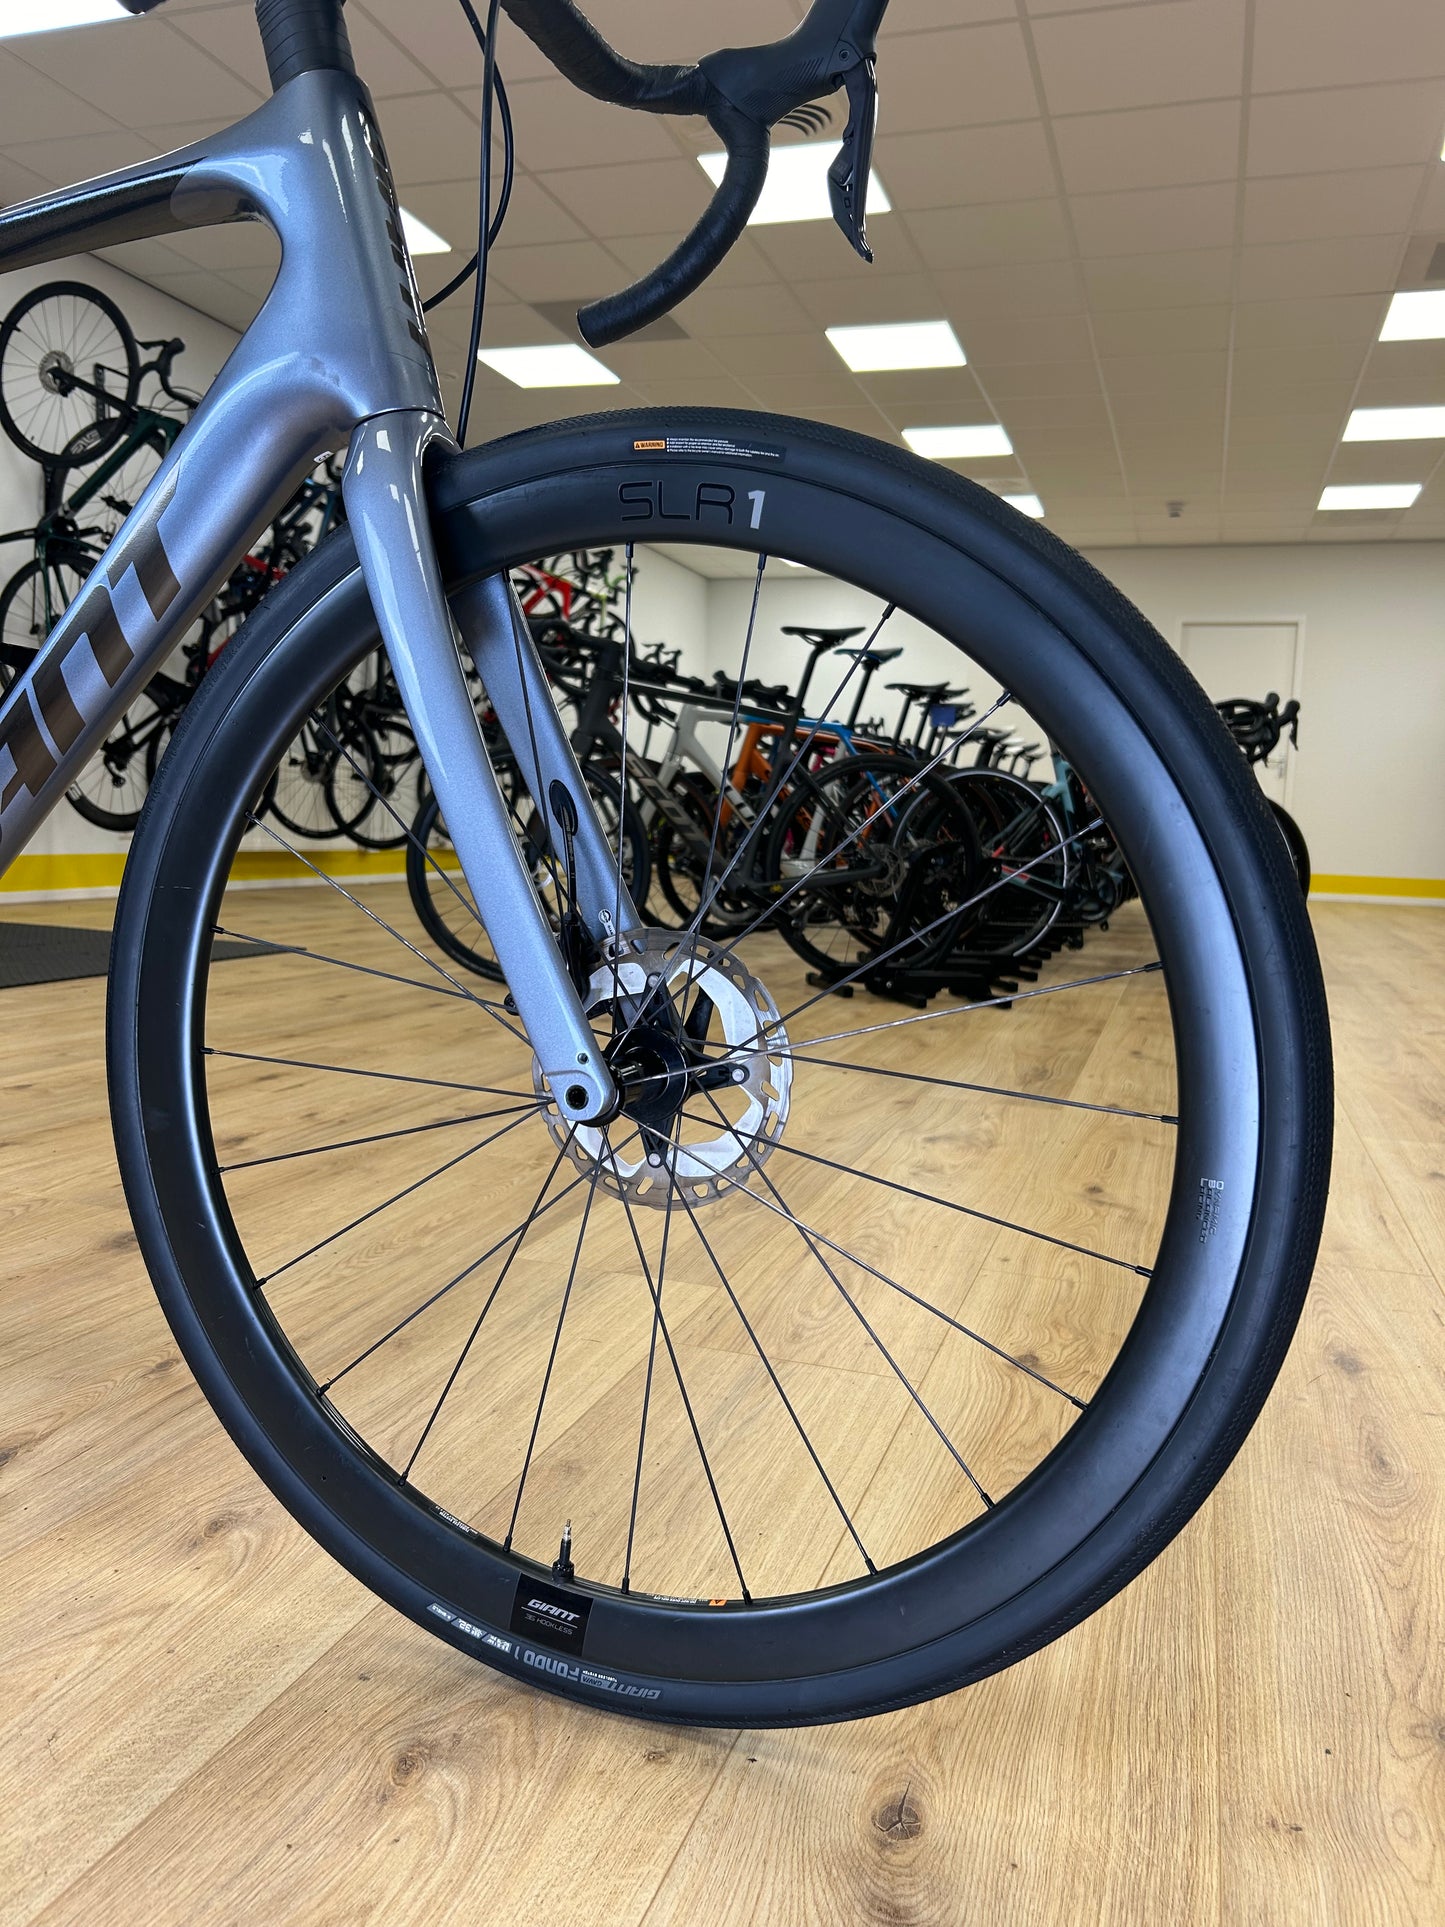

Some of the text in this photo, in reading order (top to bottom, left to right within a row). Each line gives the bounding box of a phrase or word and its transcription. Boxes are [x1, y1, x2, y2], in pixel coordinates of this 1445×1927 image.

[641, 441, 664, 449] WARNING
[618, 480, 766, 530] SLR 1
[527, 1598, 581, 1622] GIANT
[537, 1618, 573, 1635] HOOKLESS
[523, 1649, 580, 1682] FONDO
[608, 1681, 661, 1700] GIANT
